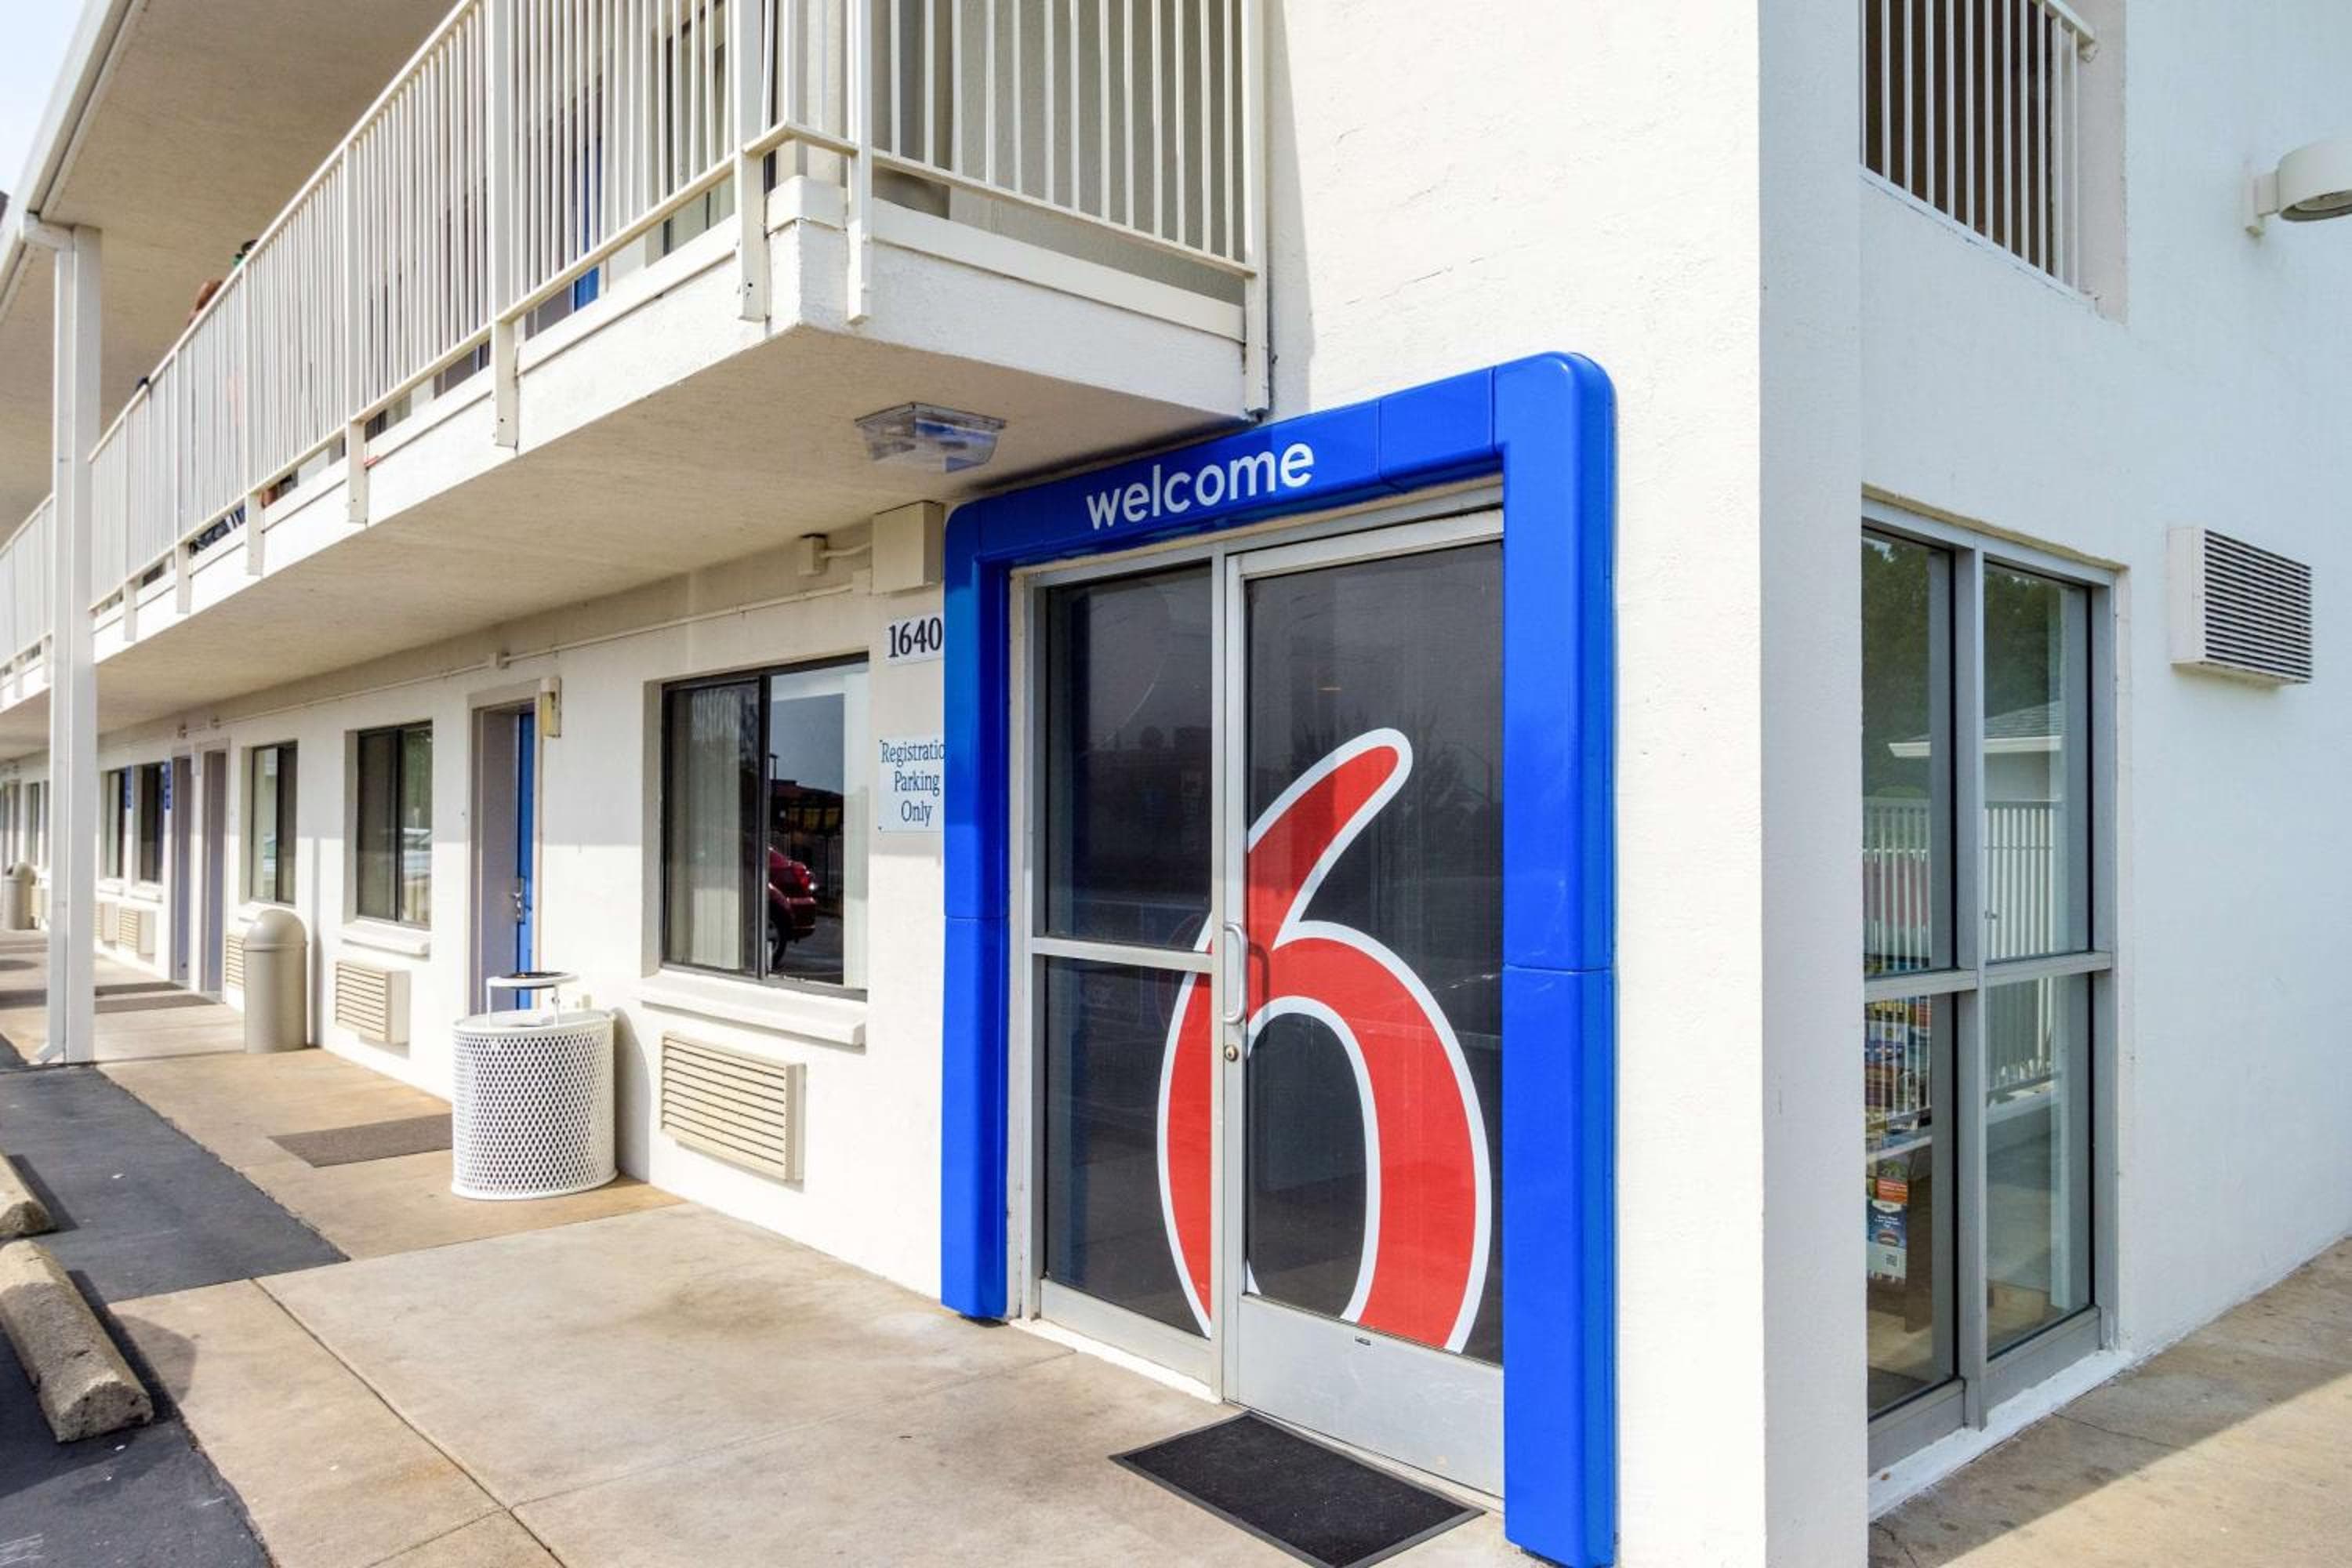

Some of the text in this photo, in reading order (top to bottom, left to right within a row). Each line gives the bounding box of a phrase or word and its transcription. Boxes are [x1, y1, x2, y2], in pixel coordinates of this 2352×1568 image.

[1087, 442, 1314, 530] welcome
[888, 617, 942, 658] 1640
[881, 740, 945, 768] Registratio
[894, 770, 940, 797] Parking
[901, 800, 932, 826] Only
[1157, 727, 1492, 1354] 6
